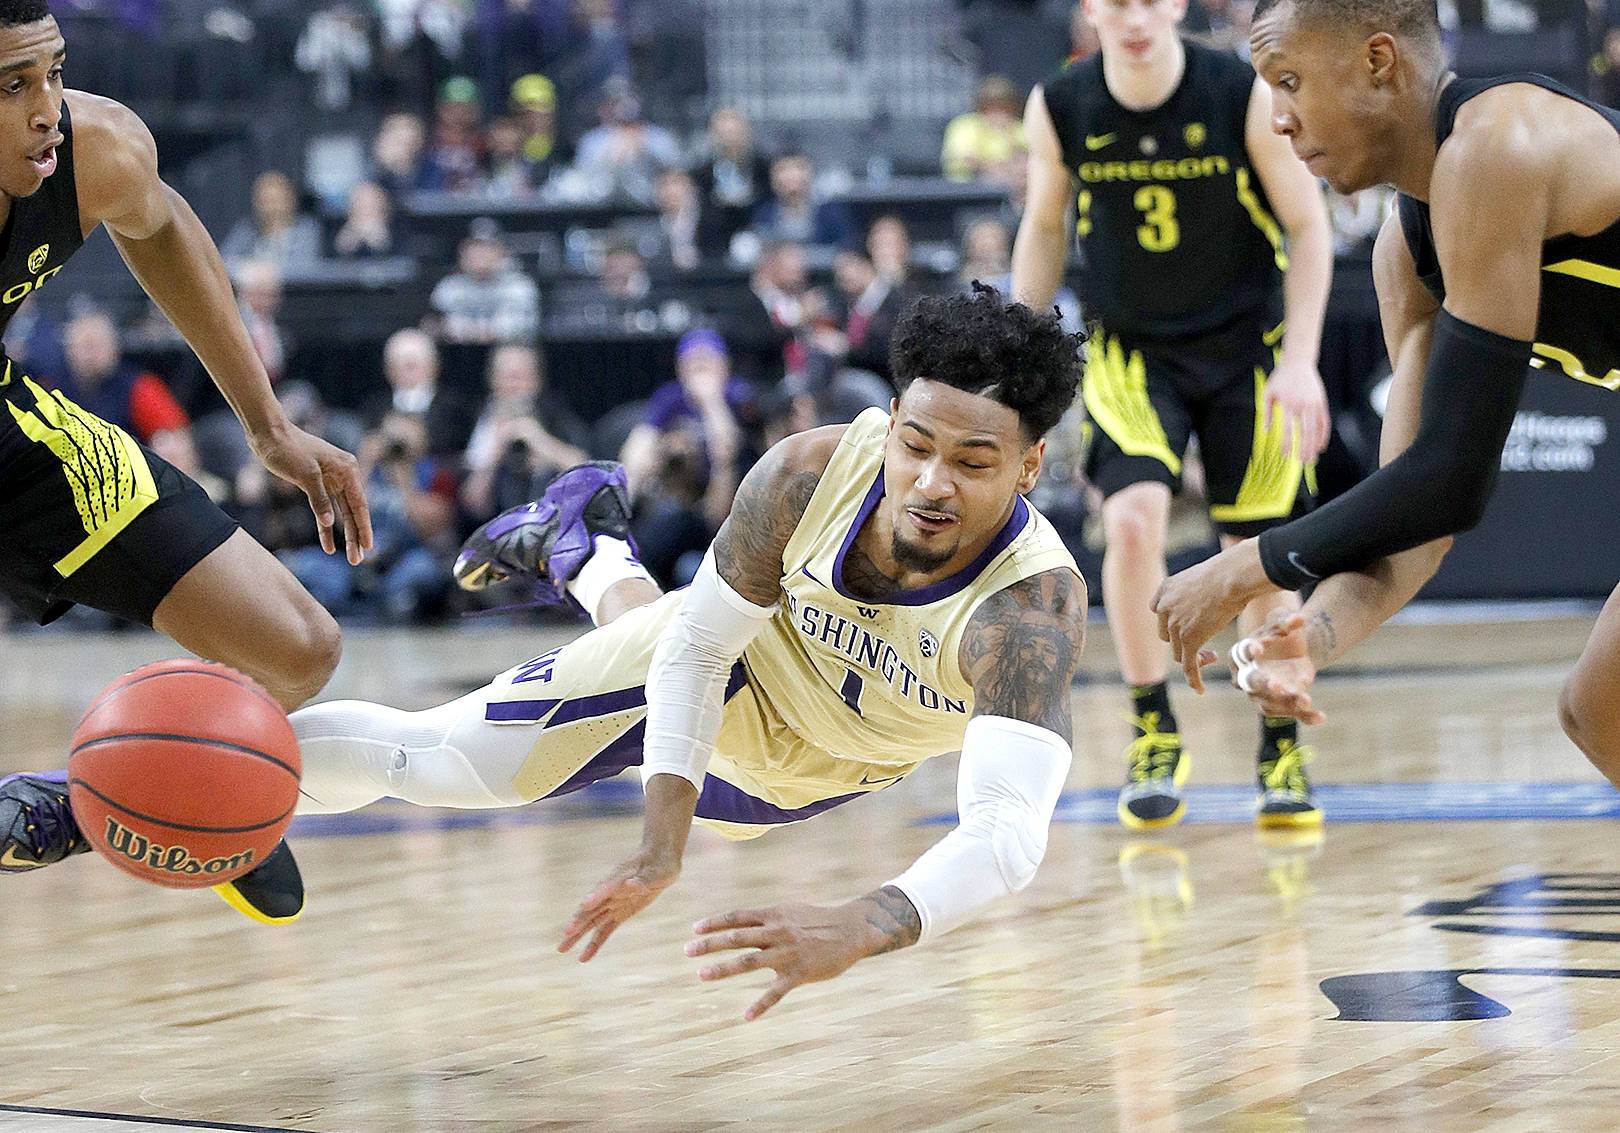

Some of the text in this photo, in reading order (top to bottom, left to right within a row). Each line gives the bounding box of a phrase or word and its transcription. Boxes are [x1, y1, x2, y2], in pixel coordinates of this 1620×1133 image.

[1078, 155, 1229, 183] OREGON
[1133, 184, 1180, 252] 3
[857, 605, 880, 619] W
[781, 585, 967, 715] SHINGTON
[840, 666, 865, 718] 1
[104, 814, 257, 876] Wilson
